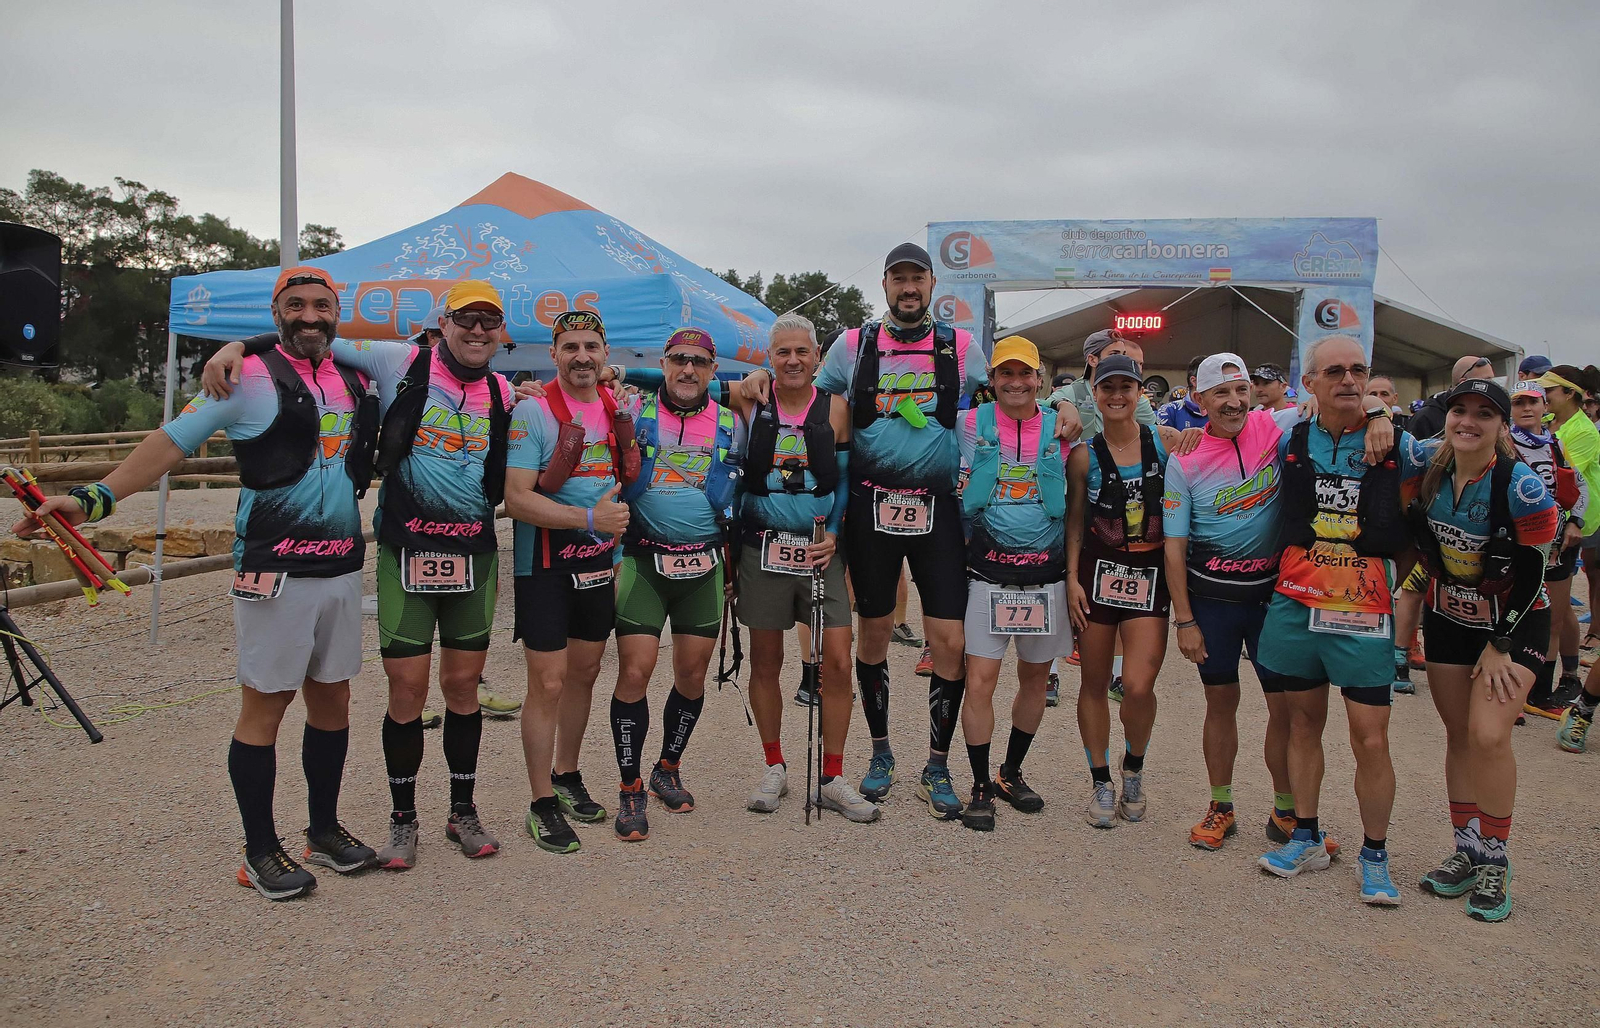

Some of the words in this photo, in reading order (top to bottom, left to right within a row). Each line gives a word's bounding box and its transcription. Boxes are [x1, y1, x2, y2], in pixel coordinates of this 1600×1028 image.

[1061, 228, 1087, 241] club
[1090, 228, 1147, 242] deportivo
[1059, 240, 1230, 260] sierracarbonera
[1083, 269, 1097, 279] La
[1128, 271, 1140, 279] de
[1141, 270, 1150, 279] la
[1152, 269, 1203, 281] Concepción
[879, 371, 936, 389] non
[421, 404, 491, 435] non
[412, 426, 490, 453] STOP
[1212, 463, 1275, 507] non
[882, 498, 925, 507] CARBONERA
[889, 505, 917, 522] 78
[1236, 512, 1255, 521] team
[404, 517, 483, 538] ALGECIRAS
[271, 537, 355, 557] ALGECIRAS
[778, 546, 807, 563] 58
[673, 557, 702, 569] 44
[984, 549, 1050, 567] ALGECIRAS
[1298, 549, 1369, 570] Algeciras
[422, 560, 455, 577] 39
[1109, 579, 1139, 596] 48
[1282, 580, 1288, 588] El
[1307, 586, 1324, 597] Rojo
[1005, 606, 1033, 621] 77
[1447, 595, 1478, 616] 29
[668, 708, 696, 753] kalenji
[616, 718, 637, 767] kalenji
